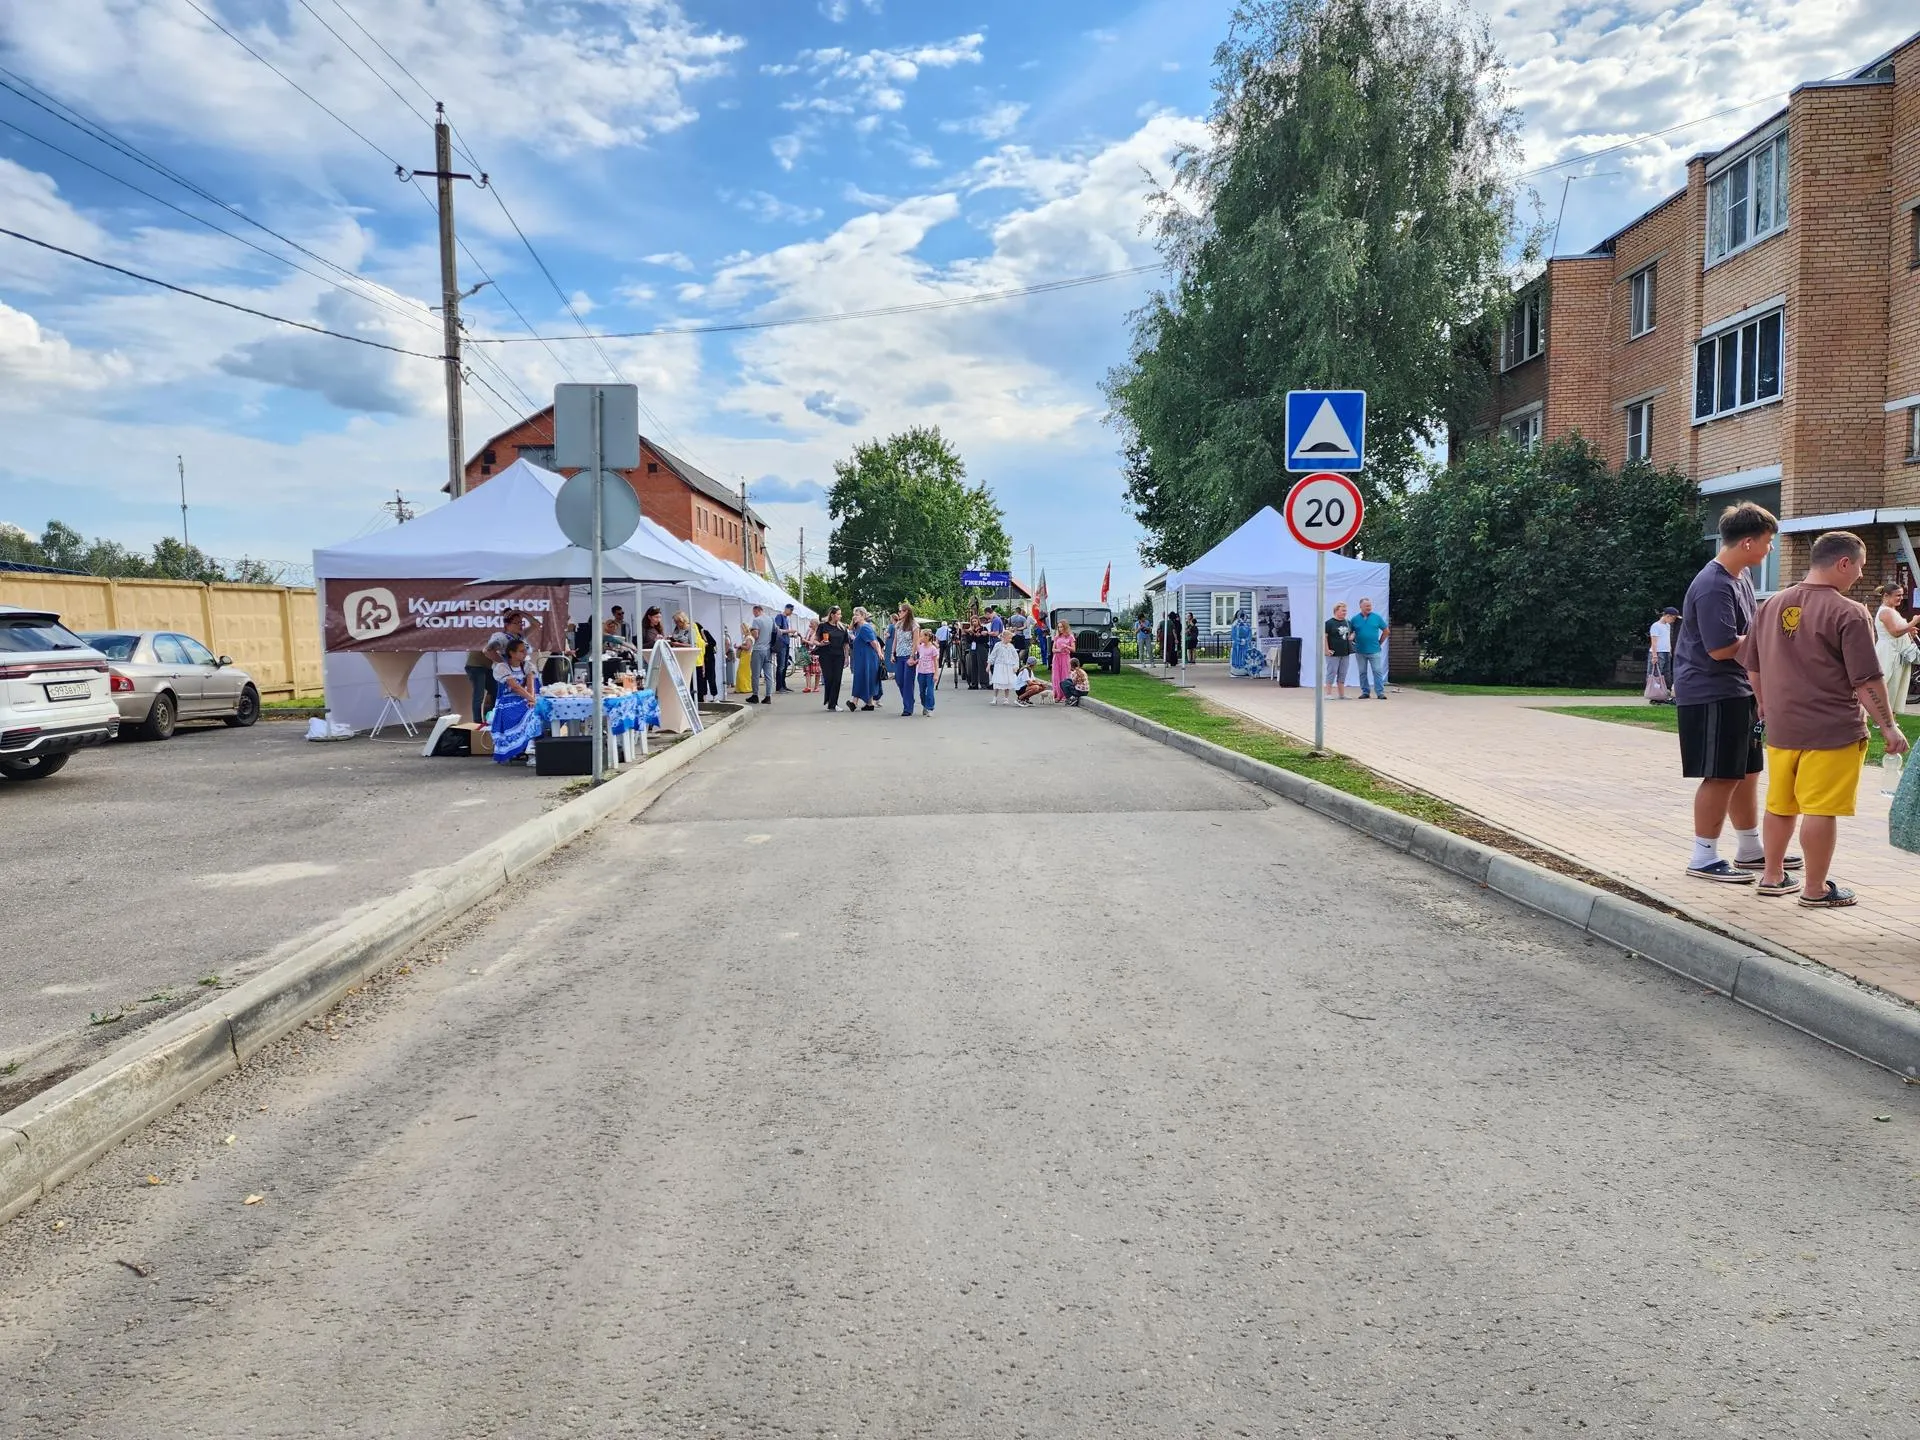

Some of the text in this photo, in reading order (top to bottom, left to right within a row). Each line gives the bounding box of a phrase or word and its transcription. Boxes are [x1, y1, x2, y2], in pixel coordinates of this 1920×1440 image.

[1305, 498, 1345, 527] 20
[408, 597, 550, 615] Кулинарная
[415, 615, 544, 629] коллек
